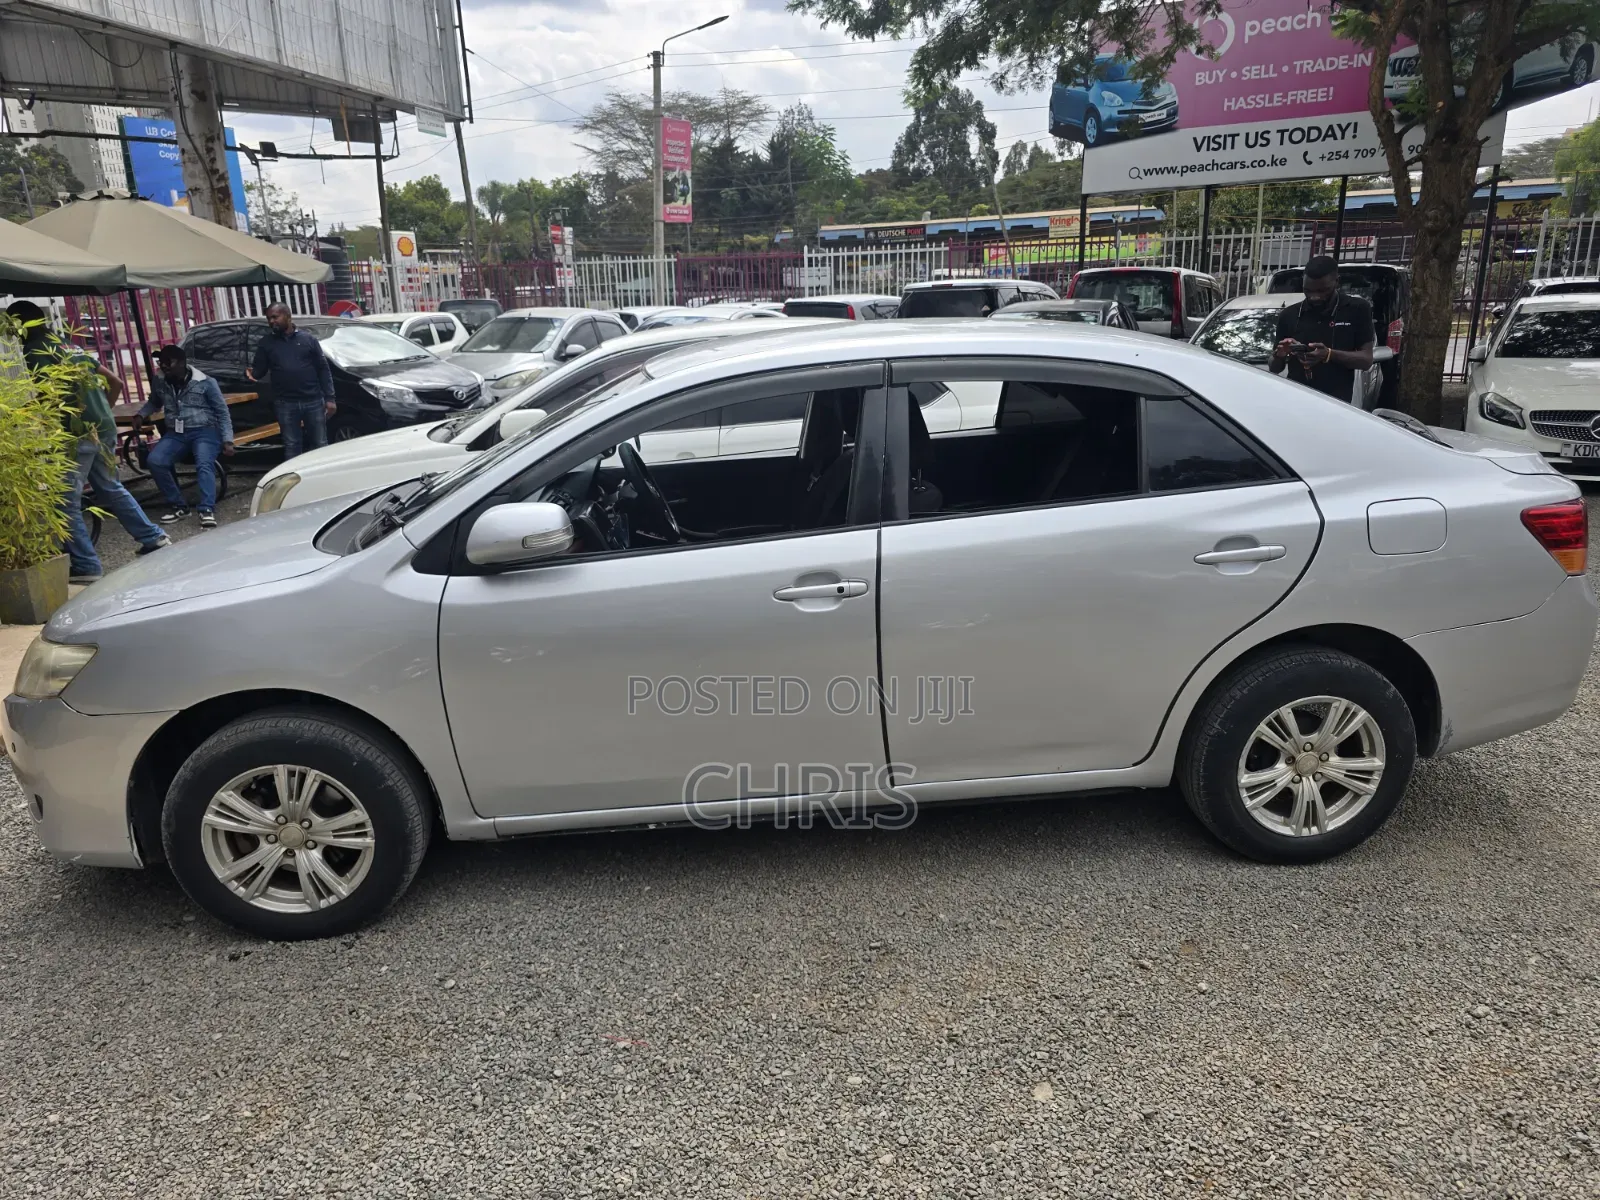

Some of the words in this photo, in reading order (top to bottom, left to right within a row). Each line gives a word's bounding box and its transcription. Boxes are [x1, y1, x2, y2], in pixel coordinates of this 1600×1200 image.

[1244, 5, 1322, 44] peach
[1195, 68, 1227, 86] BUY
[1241, 63, 1278, 81] SELL
[1293, 51, 1373, 75] TRADE-IN
[1223, 86, 1334, 112] HASSLE-FREE!
[1192, 132, 1241, 153] VISIT
[1244, 129, 1272, 149] US
[1276, 121, 1359, 147] TODAY!
[1142, 154, 1288, 177] www.peachcars.co.ke
[1319, 149, 1350, 162] +254
[1353, 147, 1377, 159] 709
[877, 229, 906, 238] DEUTSCHE
[1005, 266, 1028, 275] WSH
